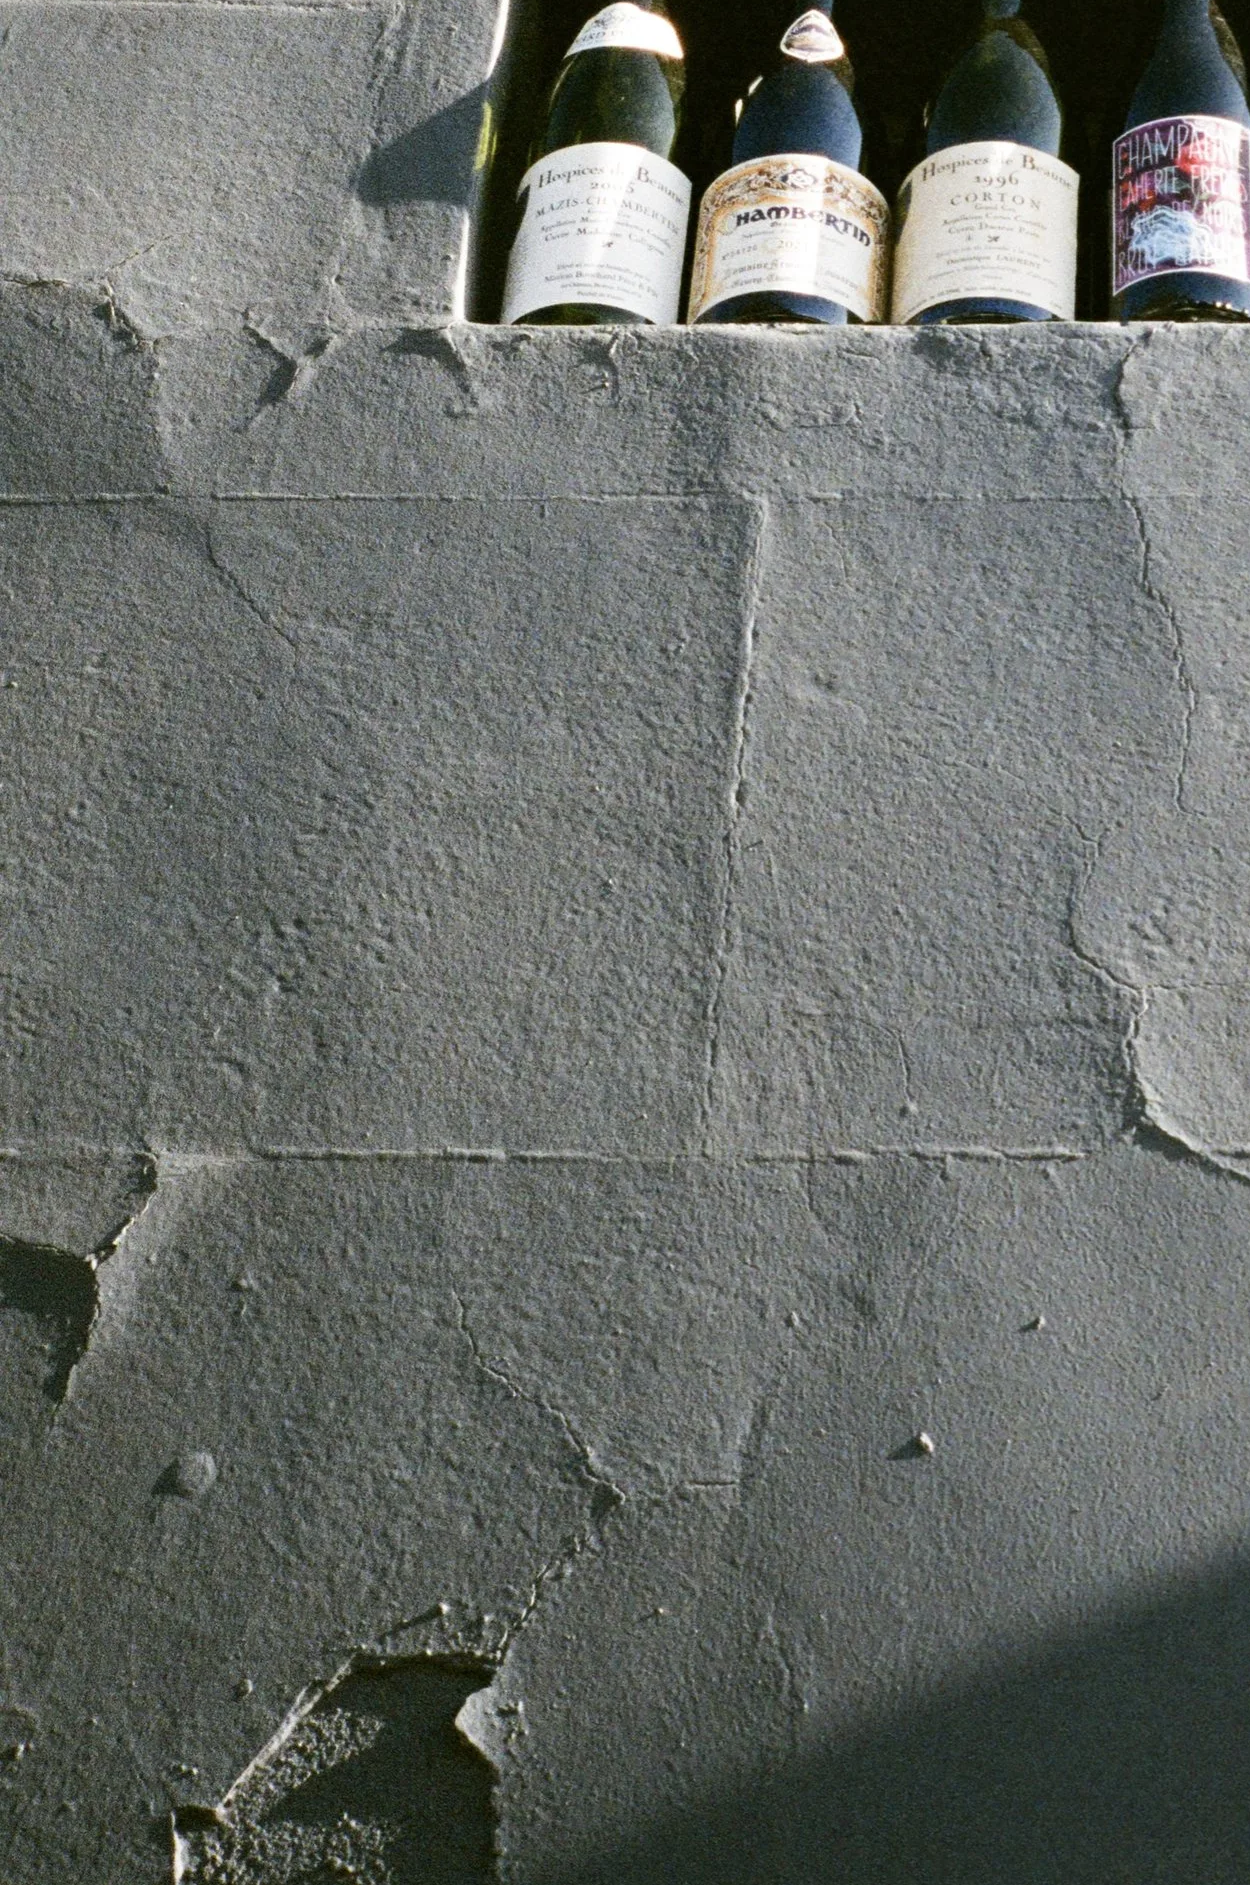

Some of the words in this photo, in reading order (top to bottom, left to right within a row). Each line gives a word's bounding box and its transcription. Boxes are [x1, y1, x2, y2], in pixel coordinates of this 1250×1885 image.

[537, 164, 604, 189] Hospices
[921, 155, 989, 182] Hospices
[1021, 154, 1073, 191] Beaune
[973, 170, 1019, 188] 1996
[949, 191, 1041, 211] CORTON
[535, 197, 681, 235] MAZIS-CHMBERTIN
